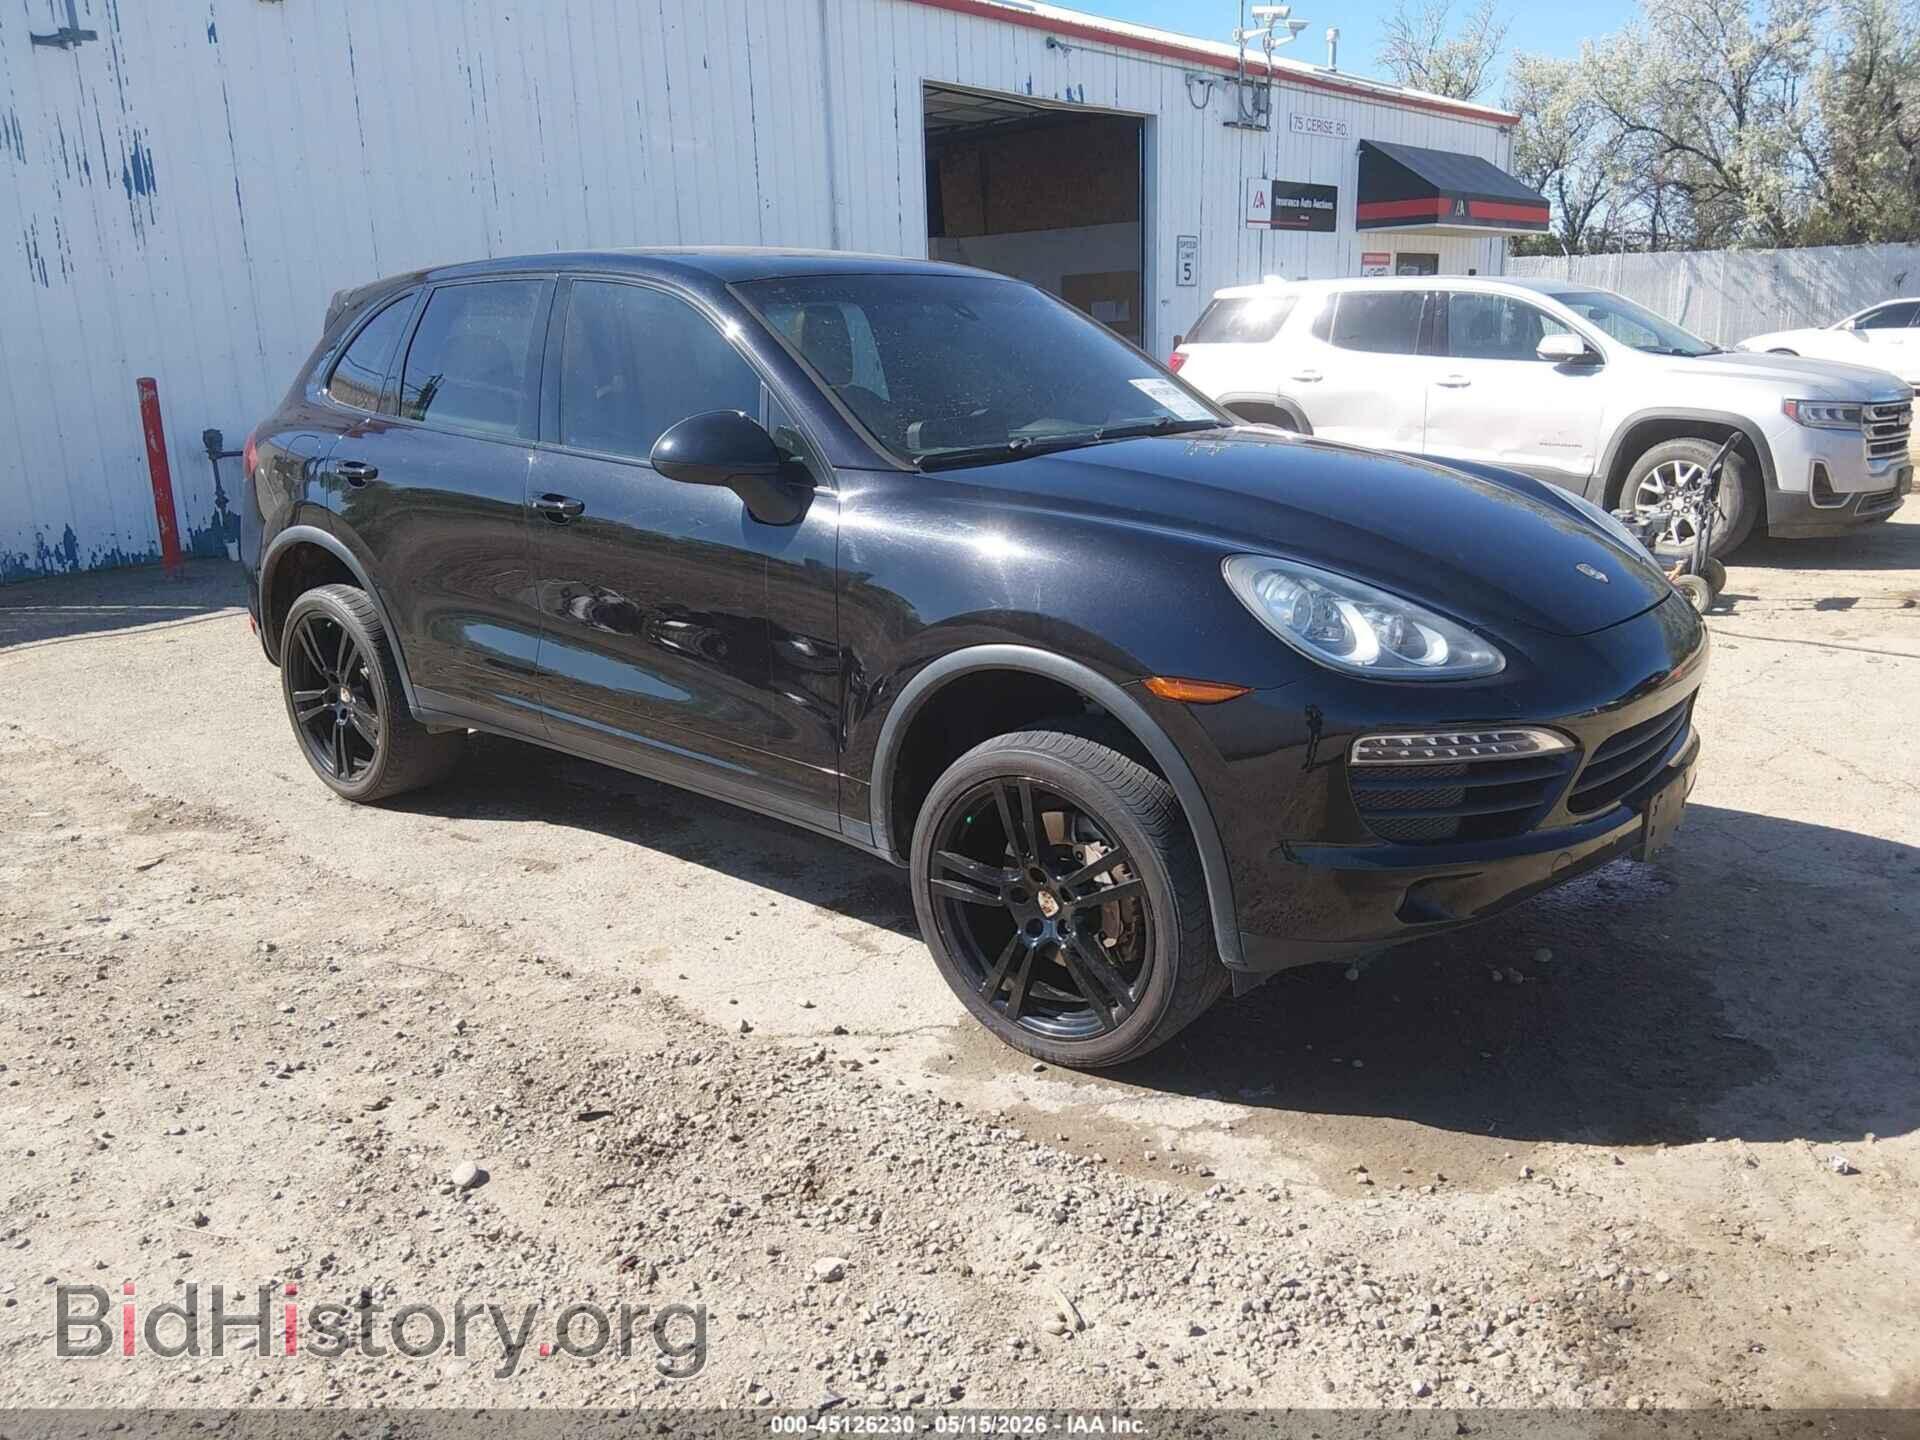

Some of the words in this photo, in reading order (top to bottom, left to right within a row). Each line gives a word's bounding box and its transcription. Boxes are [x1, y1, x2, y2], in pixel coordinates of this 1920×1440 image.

[1294, 116, 1304, 130] 75
[1306, 118, 1333, 135] CERISE
[1184, 262, 1192, 281] 5
